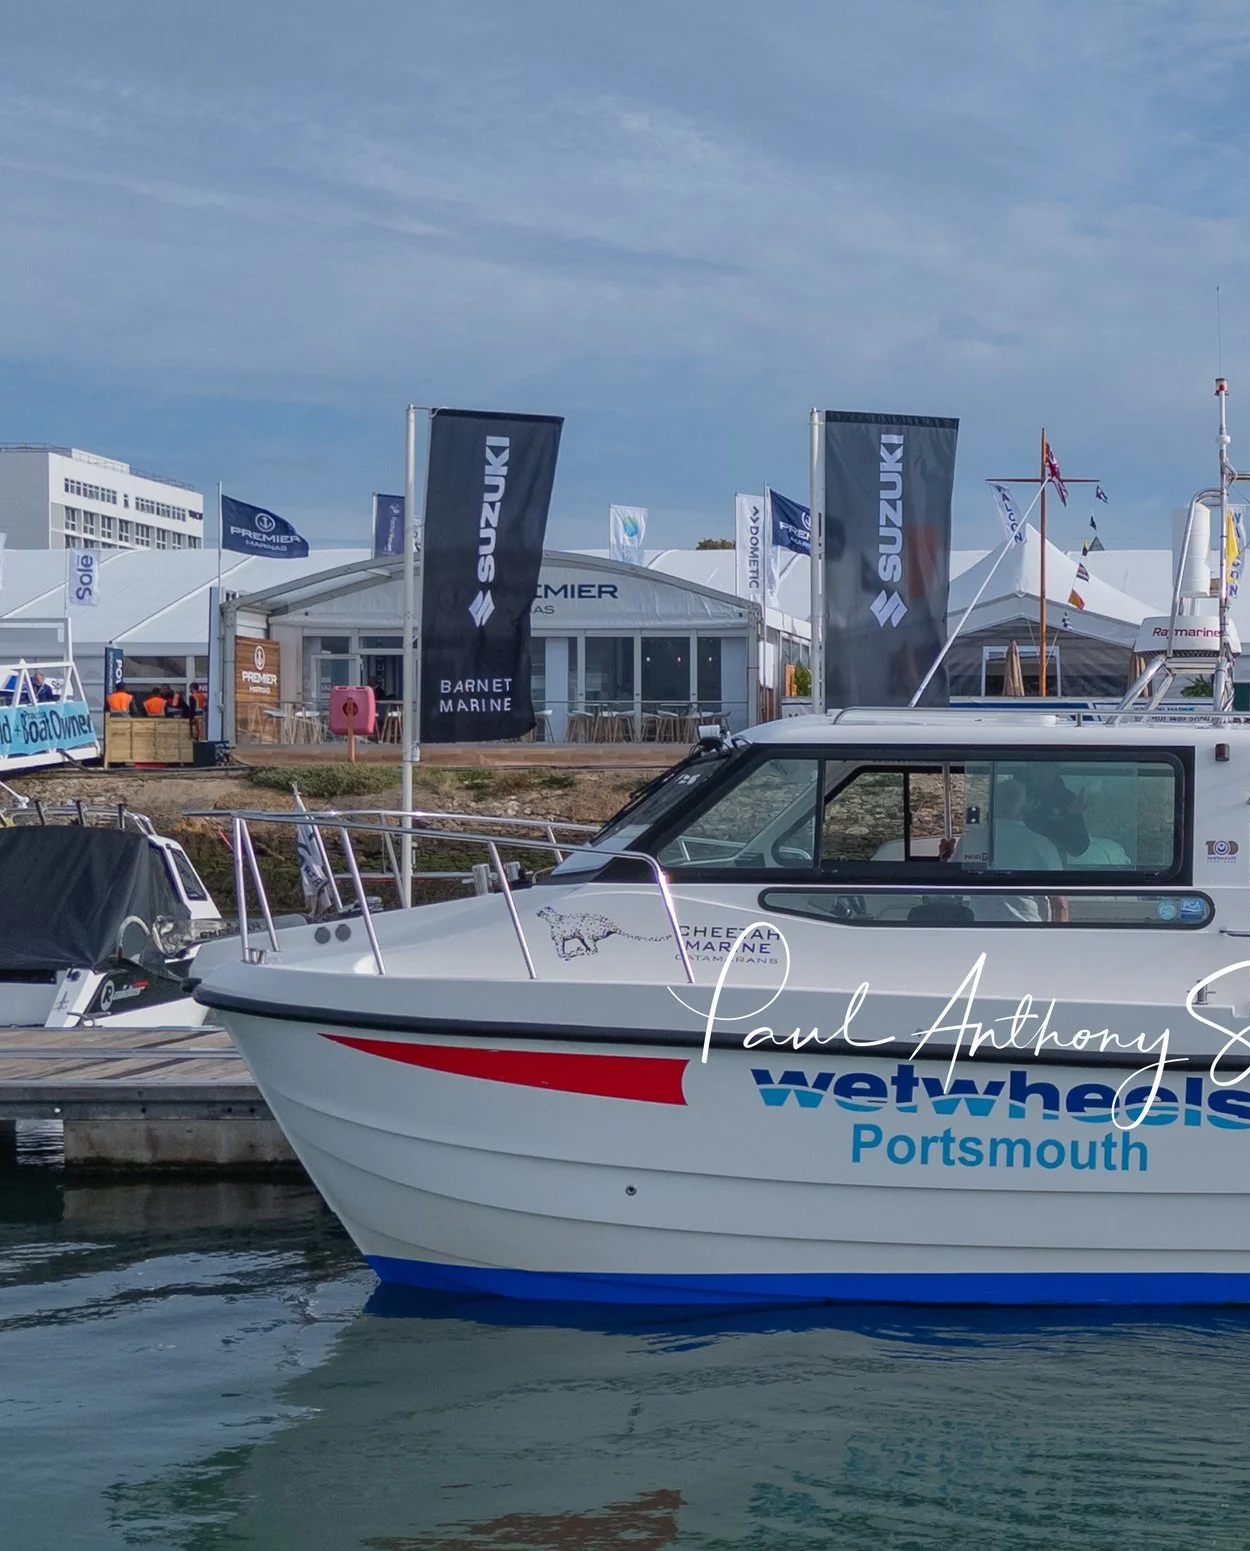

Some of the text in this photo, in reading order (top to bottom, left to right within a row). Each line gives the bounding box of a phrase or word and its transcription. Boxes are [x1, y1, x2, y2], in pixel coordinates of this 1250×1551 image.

[477, 436, 510, 584] SUZUKI
[877, 434, 904, 583] SUZUKI
[229, 525, 302, 544] PREMIER
[748, 526, 760, 589] DOMETIC
[241, 671, 278, 685] PREMIER
[440, 678, 513, 693] BARNET
[439, 698, 512, 712] MARINE
[1182, 901, 1201, 909] PCA
[685, 941, 772, 954] MARNE
[852, 1123, 1149, 1172] Portsmouth
